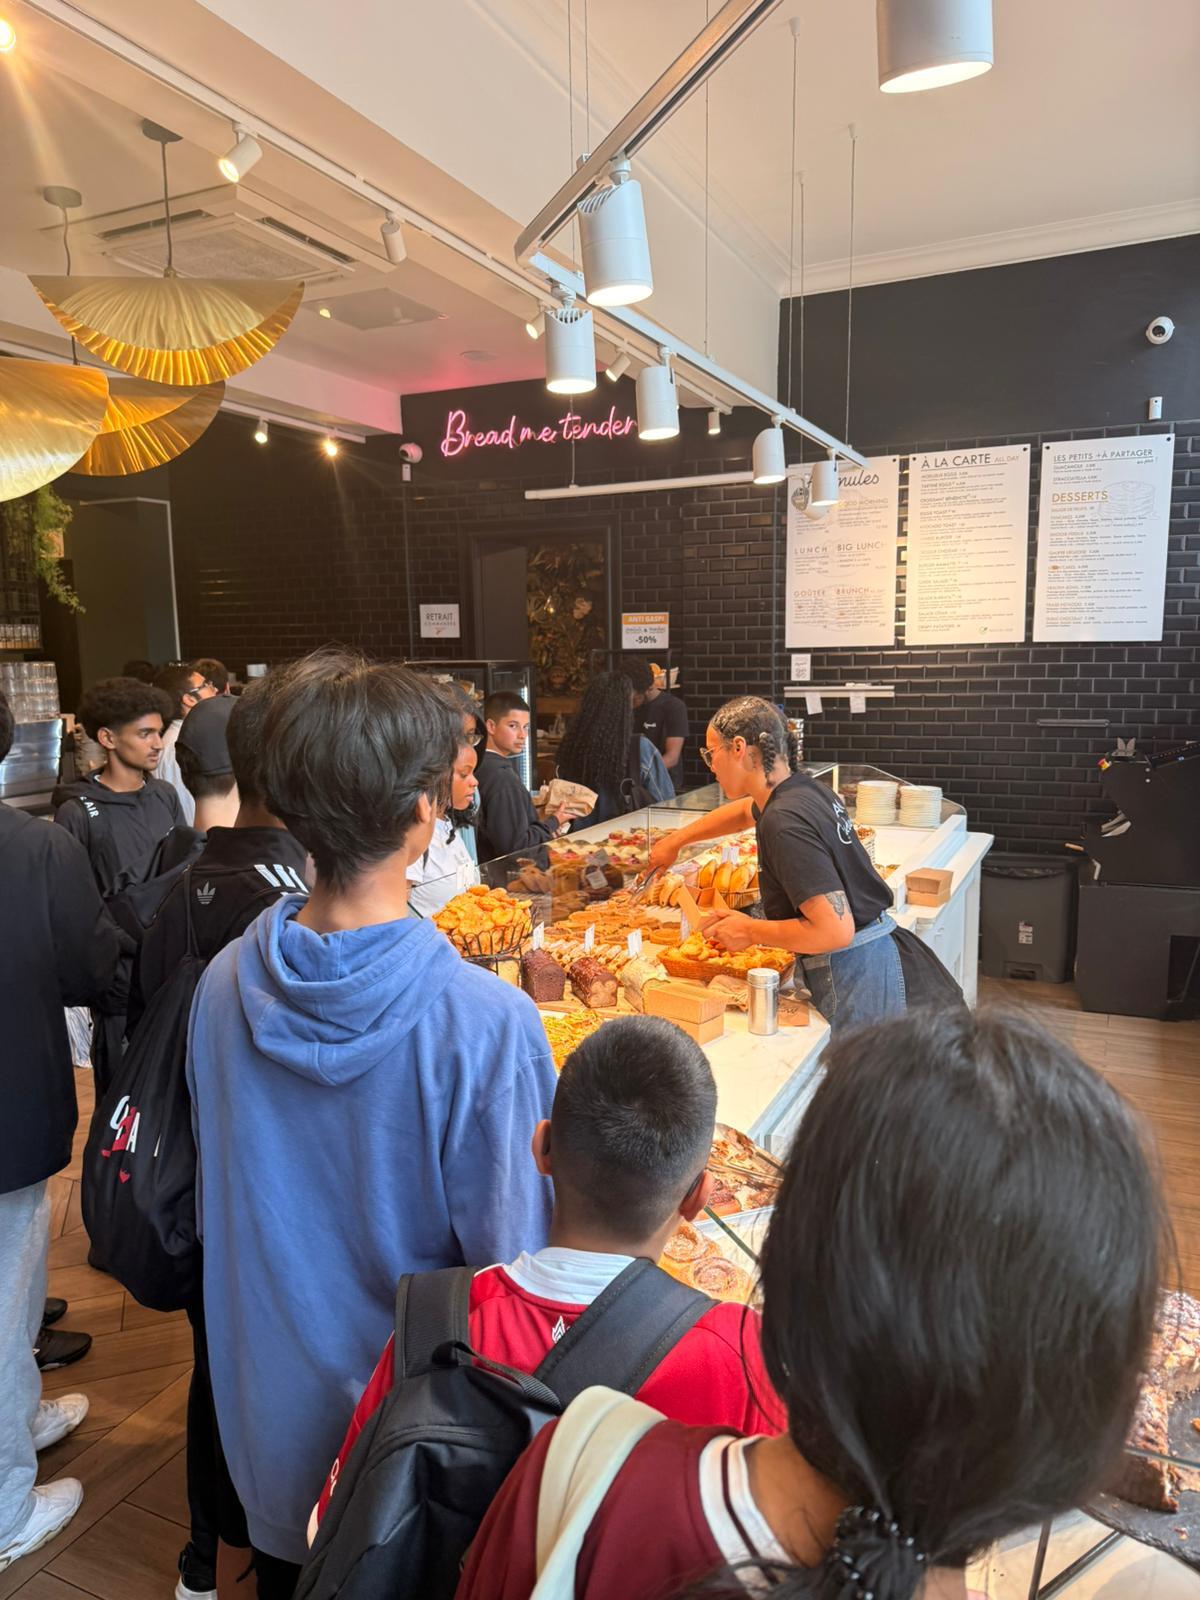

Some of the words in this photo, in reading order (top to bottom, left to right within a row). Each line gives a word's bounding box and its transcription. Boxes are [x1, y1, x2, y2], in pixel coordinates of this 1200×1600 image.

[441, 409, 516, 456] Bread
[520, 426, 558, 443] me
[559, 405, 638, 439] tender
[1069, 452, 1094, 461] PETITS
[1110, 448, 1154, 458] PARTAGER
[934, 457, 950, 468] LA
[952, 453, 992, 467] CARTE
[1052, 491, 1108, 502] DESSERTS
[794, 546, 828, 555] LUNCH
[837, 543, 853, 552] BIG
[836, 587, 870, 595] BRUNCH
[426, 612, 453, 621] RETRAIT
[635, 635, 657, 644] -50%
[84, 801, 99, 818] AIR
